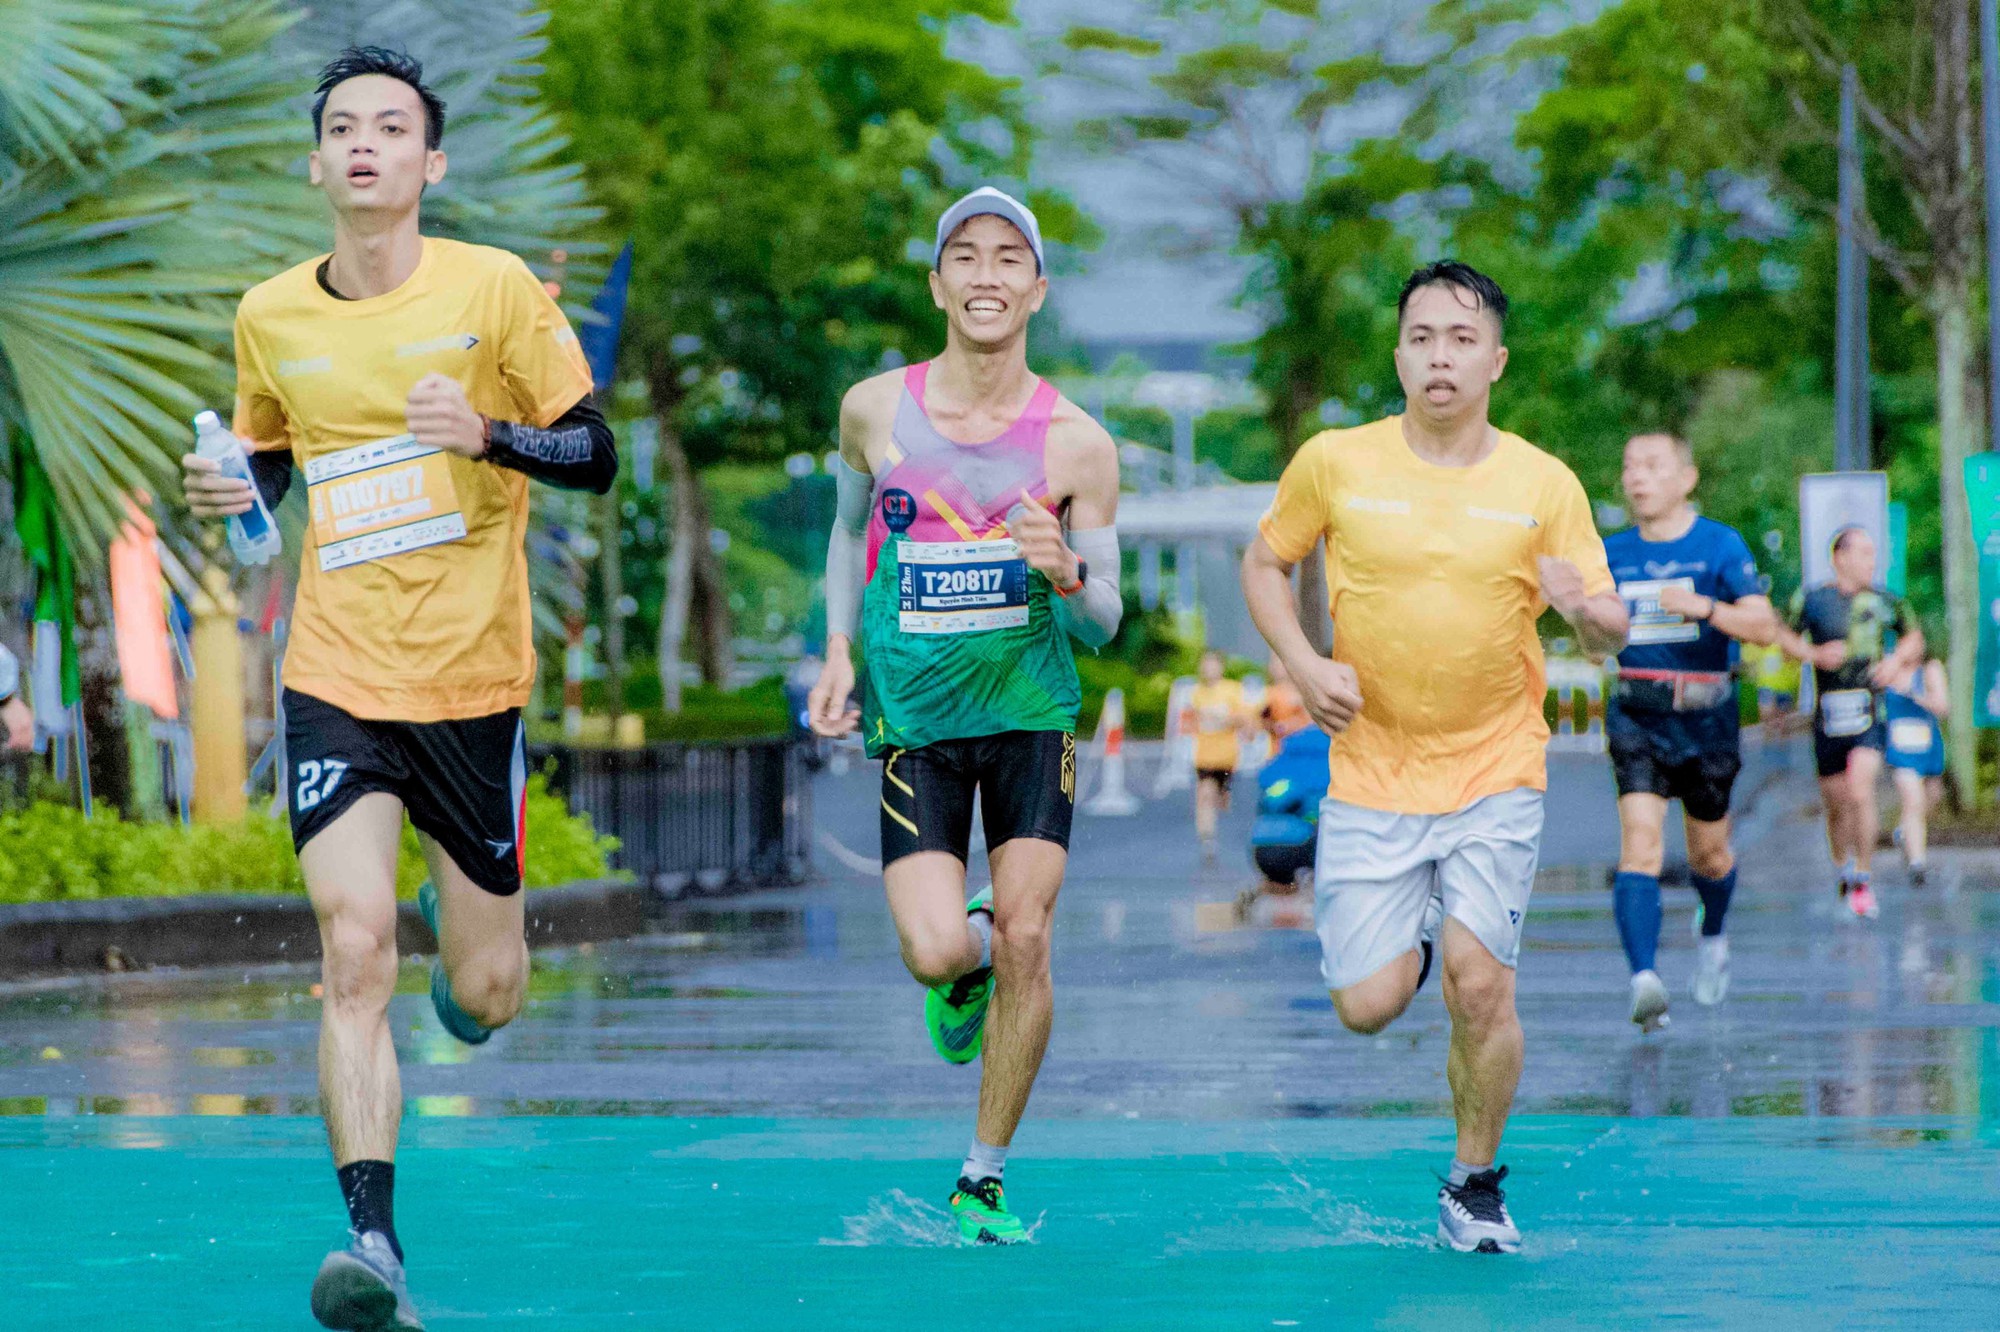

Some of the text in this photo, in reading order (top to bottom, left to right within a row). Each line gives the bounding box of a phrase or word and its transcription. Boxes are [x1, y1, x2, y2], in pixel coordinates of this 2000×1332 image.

[901, 566, 912, 594] 21km
[922, 568, 1004, 594] T20817
[297, 758, 349, 812] 27
